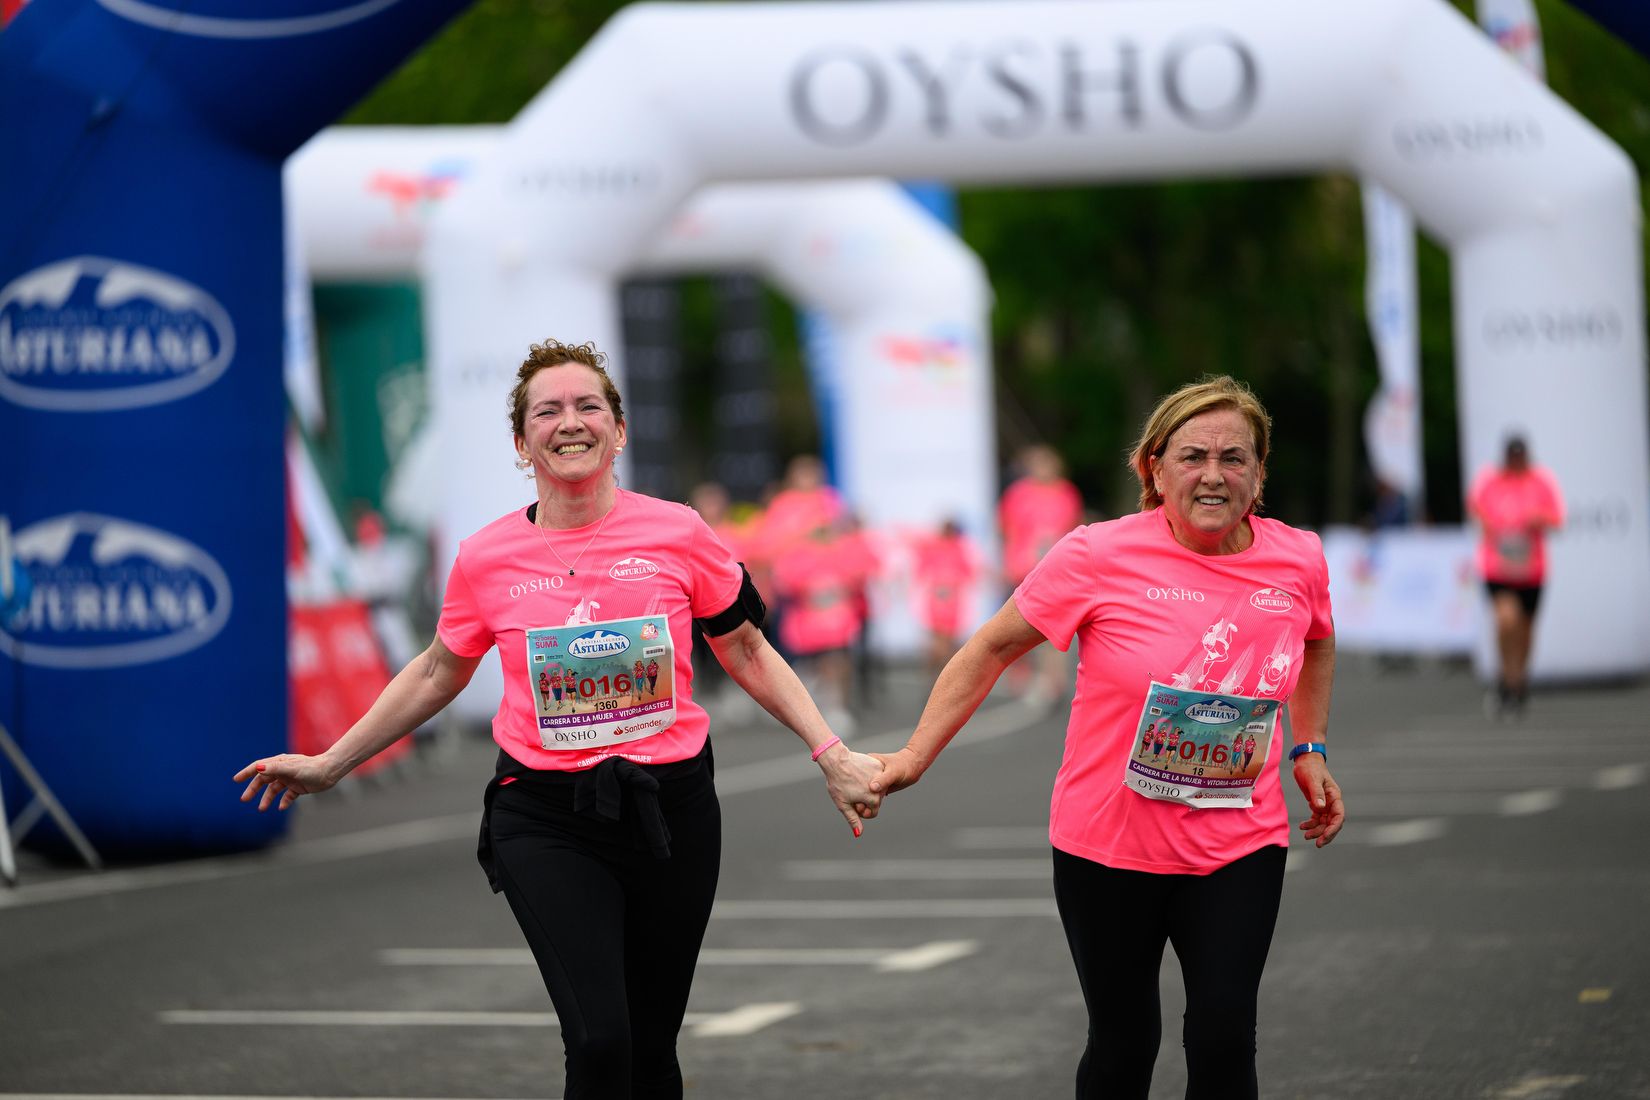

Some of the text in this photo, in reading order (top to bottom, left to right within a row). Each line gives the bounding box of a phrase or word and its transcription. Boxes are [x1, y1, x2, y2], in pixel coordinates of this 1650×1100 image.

[790, 30, 1259, 145] OYSHO
[614, 566, 657, 577] ASTURIANA
[509, 575, 564, 599] OYSHO
[1146, 587, 1205, 602] OYSHO
[1255, 596, 1291, 608] ASTURIANA
[643, 625, 655, 636] 20
[535, 640, 559, 649] SUMA
[572, 641, 627, 655] ASTURIANA
[579, 673, 632, 698] 016
[593, 700, 618, 711] 1360
[1156, 696, 1179, 706] SUMA
[543, 700, 670, 726] CARRERA DE LA MUJER VITORIA-GASTEIZ
[1188, 706, 1236, 720] ASTURIANA
[555, 720, 663, 742] OYSHO Santander
[1179, 740, 1229, 764] 016
[1132, 762, 1160, 778] CARRERA
[1161, 771, 1170, 780] DE
[1171, 773, 1180, 782] LA
[1181, 776, 1202, 785] MUJER
[1192, 767, 1204, 776] 18
[1138, 779, 1181, 798] OYSHO
